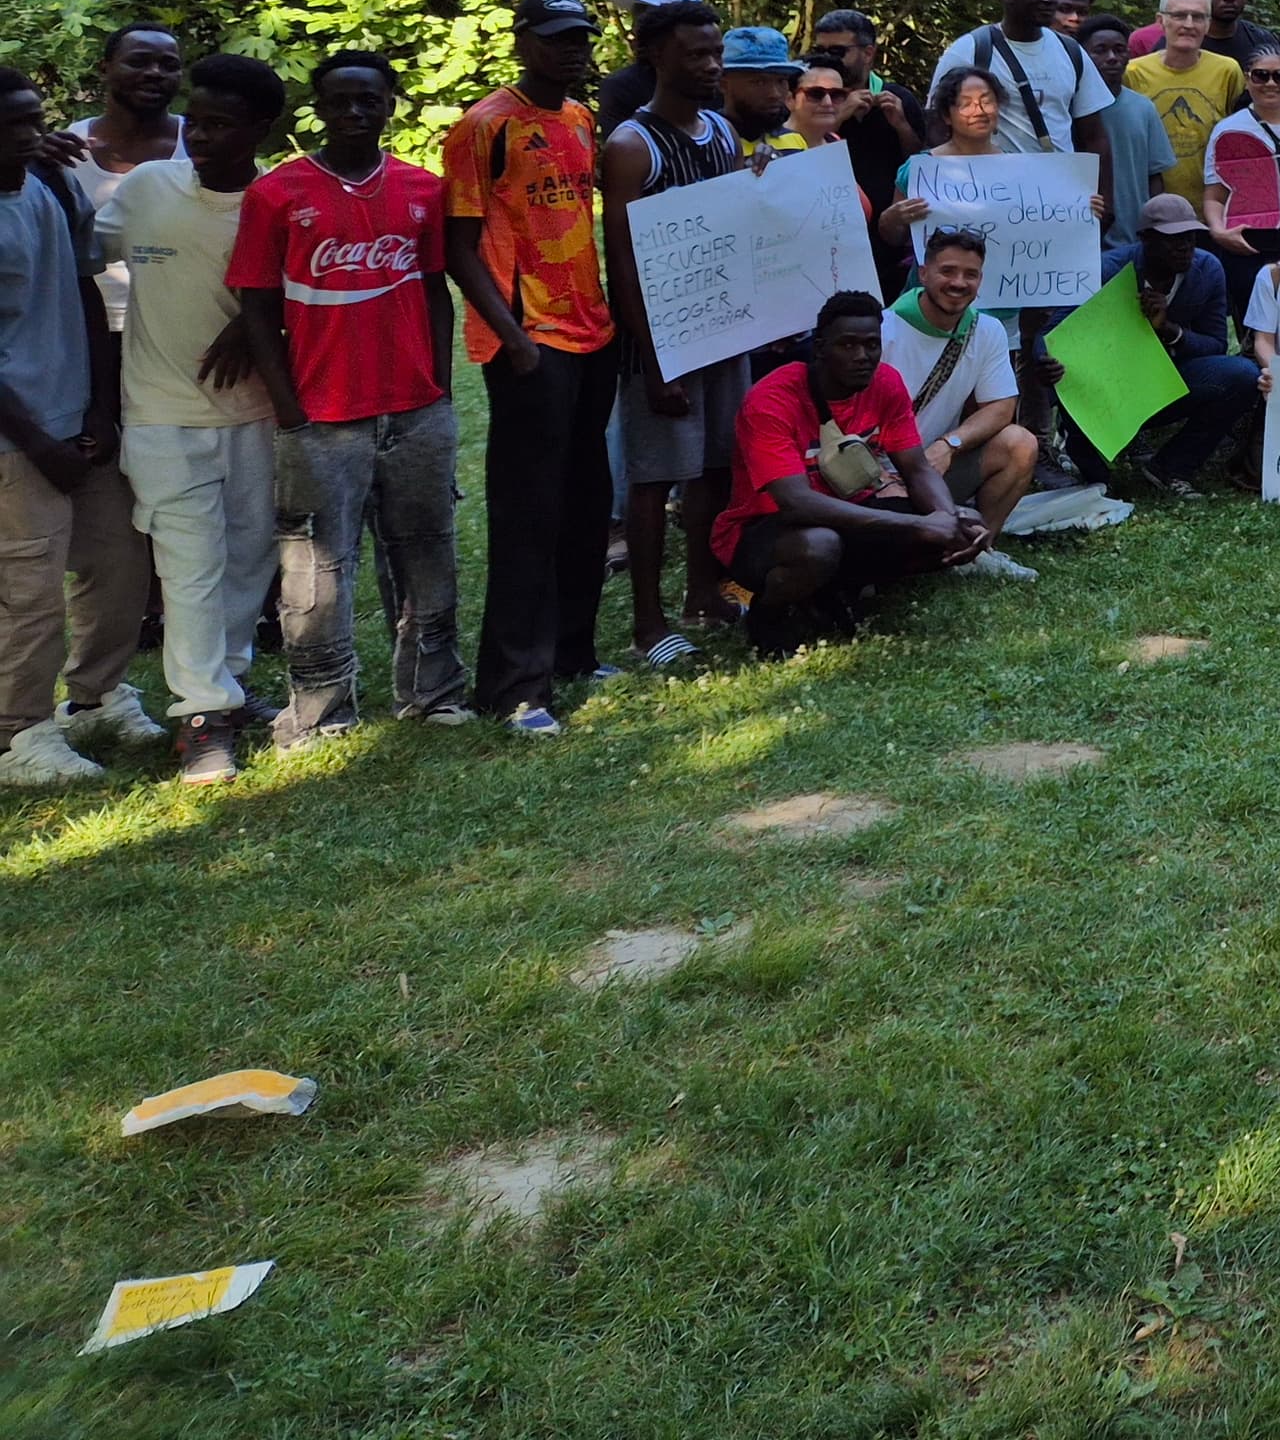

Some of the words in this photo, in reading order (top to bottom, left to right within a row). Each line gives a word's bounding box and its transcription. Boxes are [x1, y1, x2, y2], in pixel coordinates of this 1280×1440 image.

[916, 161, 1012, 203] Nadie
[1010, 238, 1053, 268] por
[645, 263, 730, 307] ACEPTAR
[998, 270, 1095, 299] MUJER
